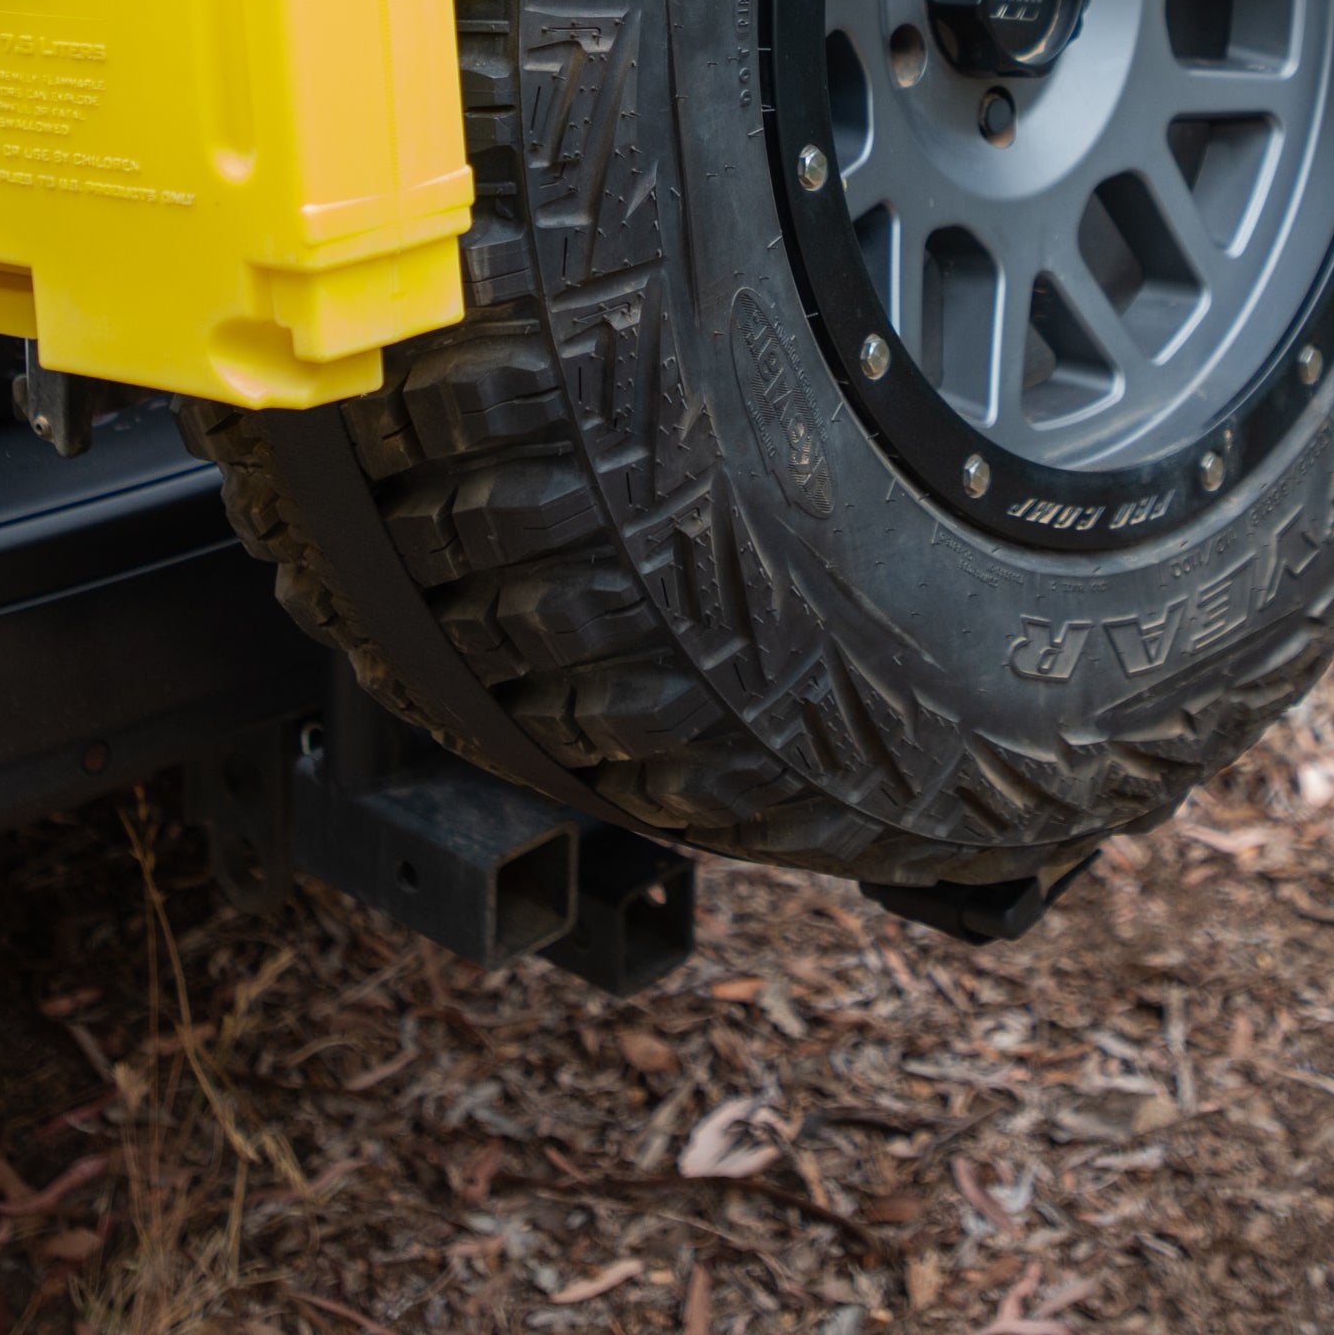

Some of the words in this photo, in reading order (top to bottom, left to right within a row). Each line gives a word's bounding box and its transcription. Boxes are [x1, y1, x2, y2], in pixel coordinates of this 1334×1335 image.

[38, 35, 108, 64] LITERS
[25, 88, 48, 102] CAN
[50, 90, 101, 107] EXPLODE
[42, 73, 106, 92] FLAMMABLE
[2, 142, 20, 157] OR
[23, 147, 51, 162] USE
[53, 150, 70, 164] BY
[72, 151, 141, 173] CHILDREN
[36, 174, 56, 188] TO
[83, 179, 157, 203] PRODUCTS
[160, 188, 197, 207] ONLY
[1006, 496, 1107, 532] COMP
[1107, 488, 1176, 530] PRO
